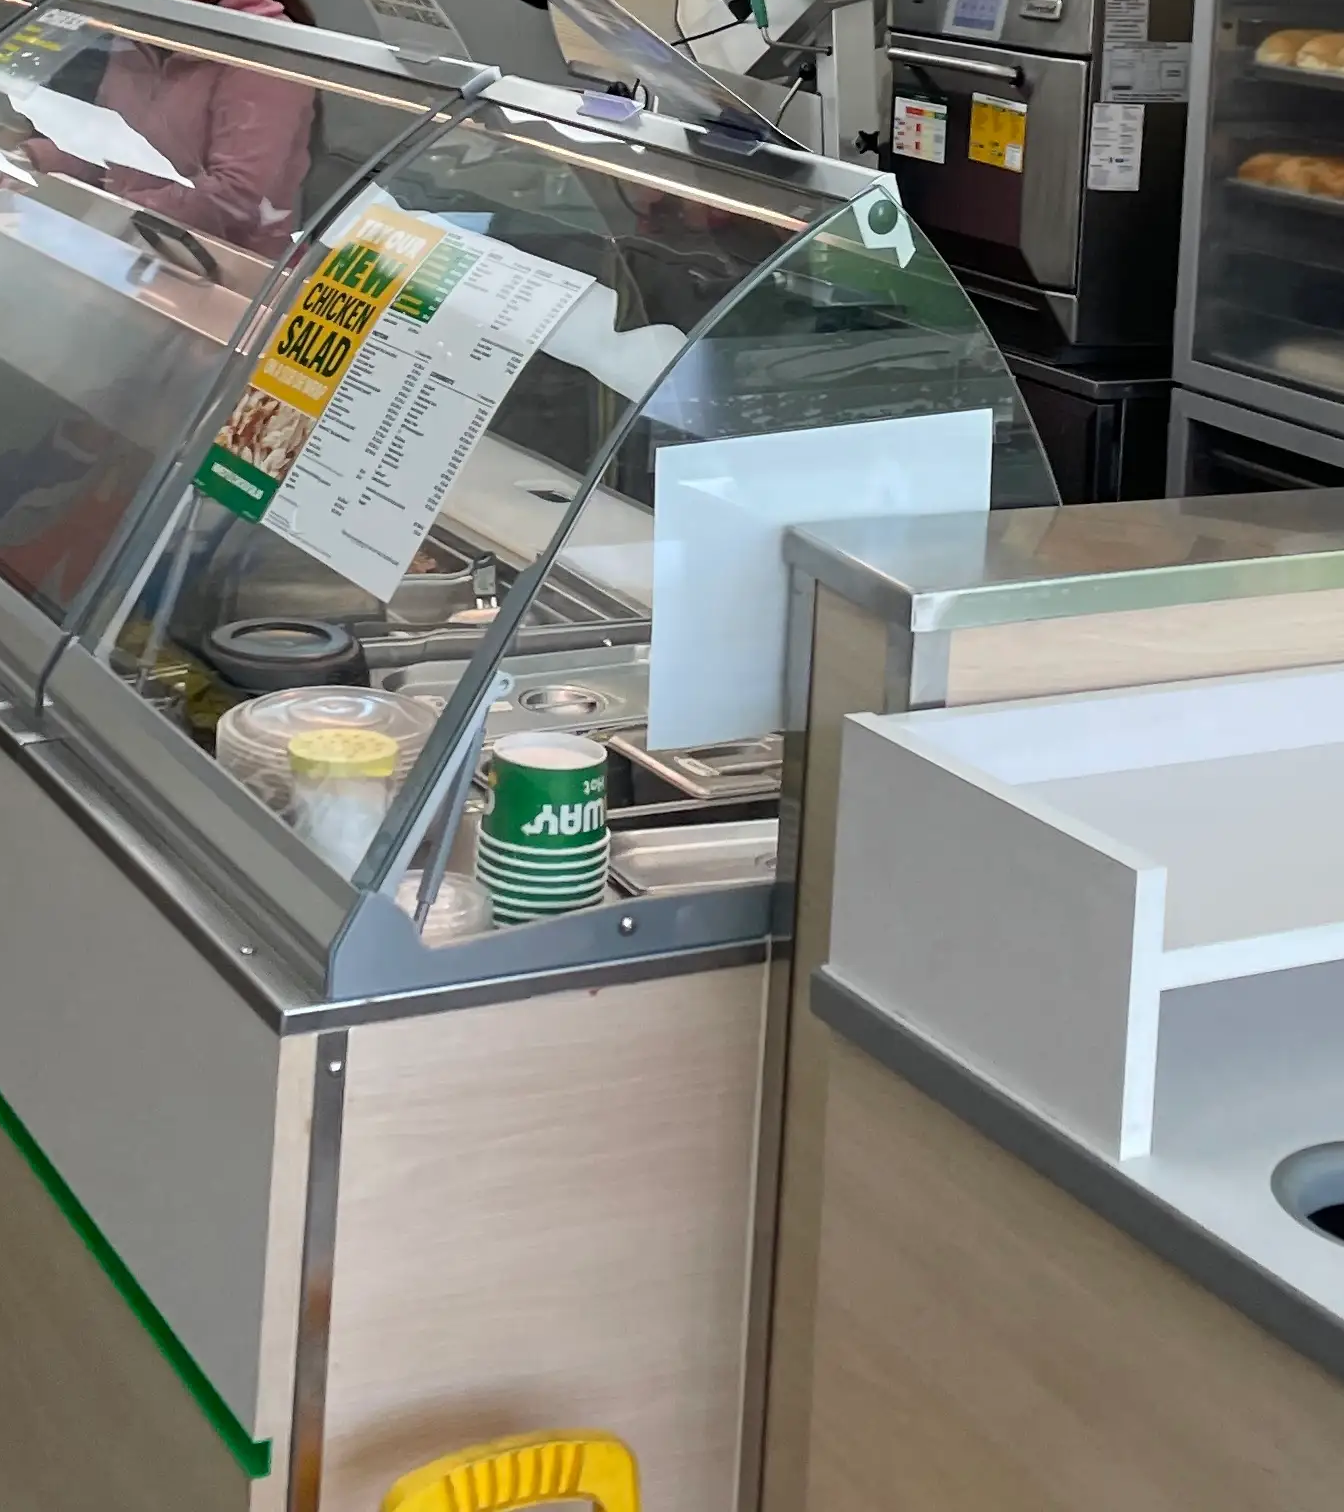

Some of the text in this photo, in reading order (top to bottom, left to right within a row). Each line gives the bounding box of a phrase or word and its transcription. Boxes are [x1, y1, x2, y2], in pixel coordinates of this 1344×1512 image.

[324, 241, 408, 299] NEW
[302, 282, 377, 334] CHICKEN
[277, 315, 351, 378] SALAD
